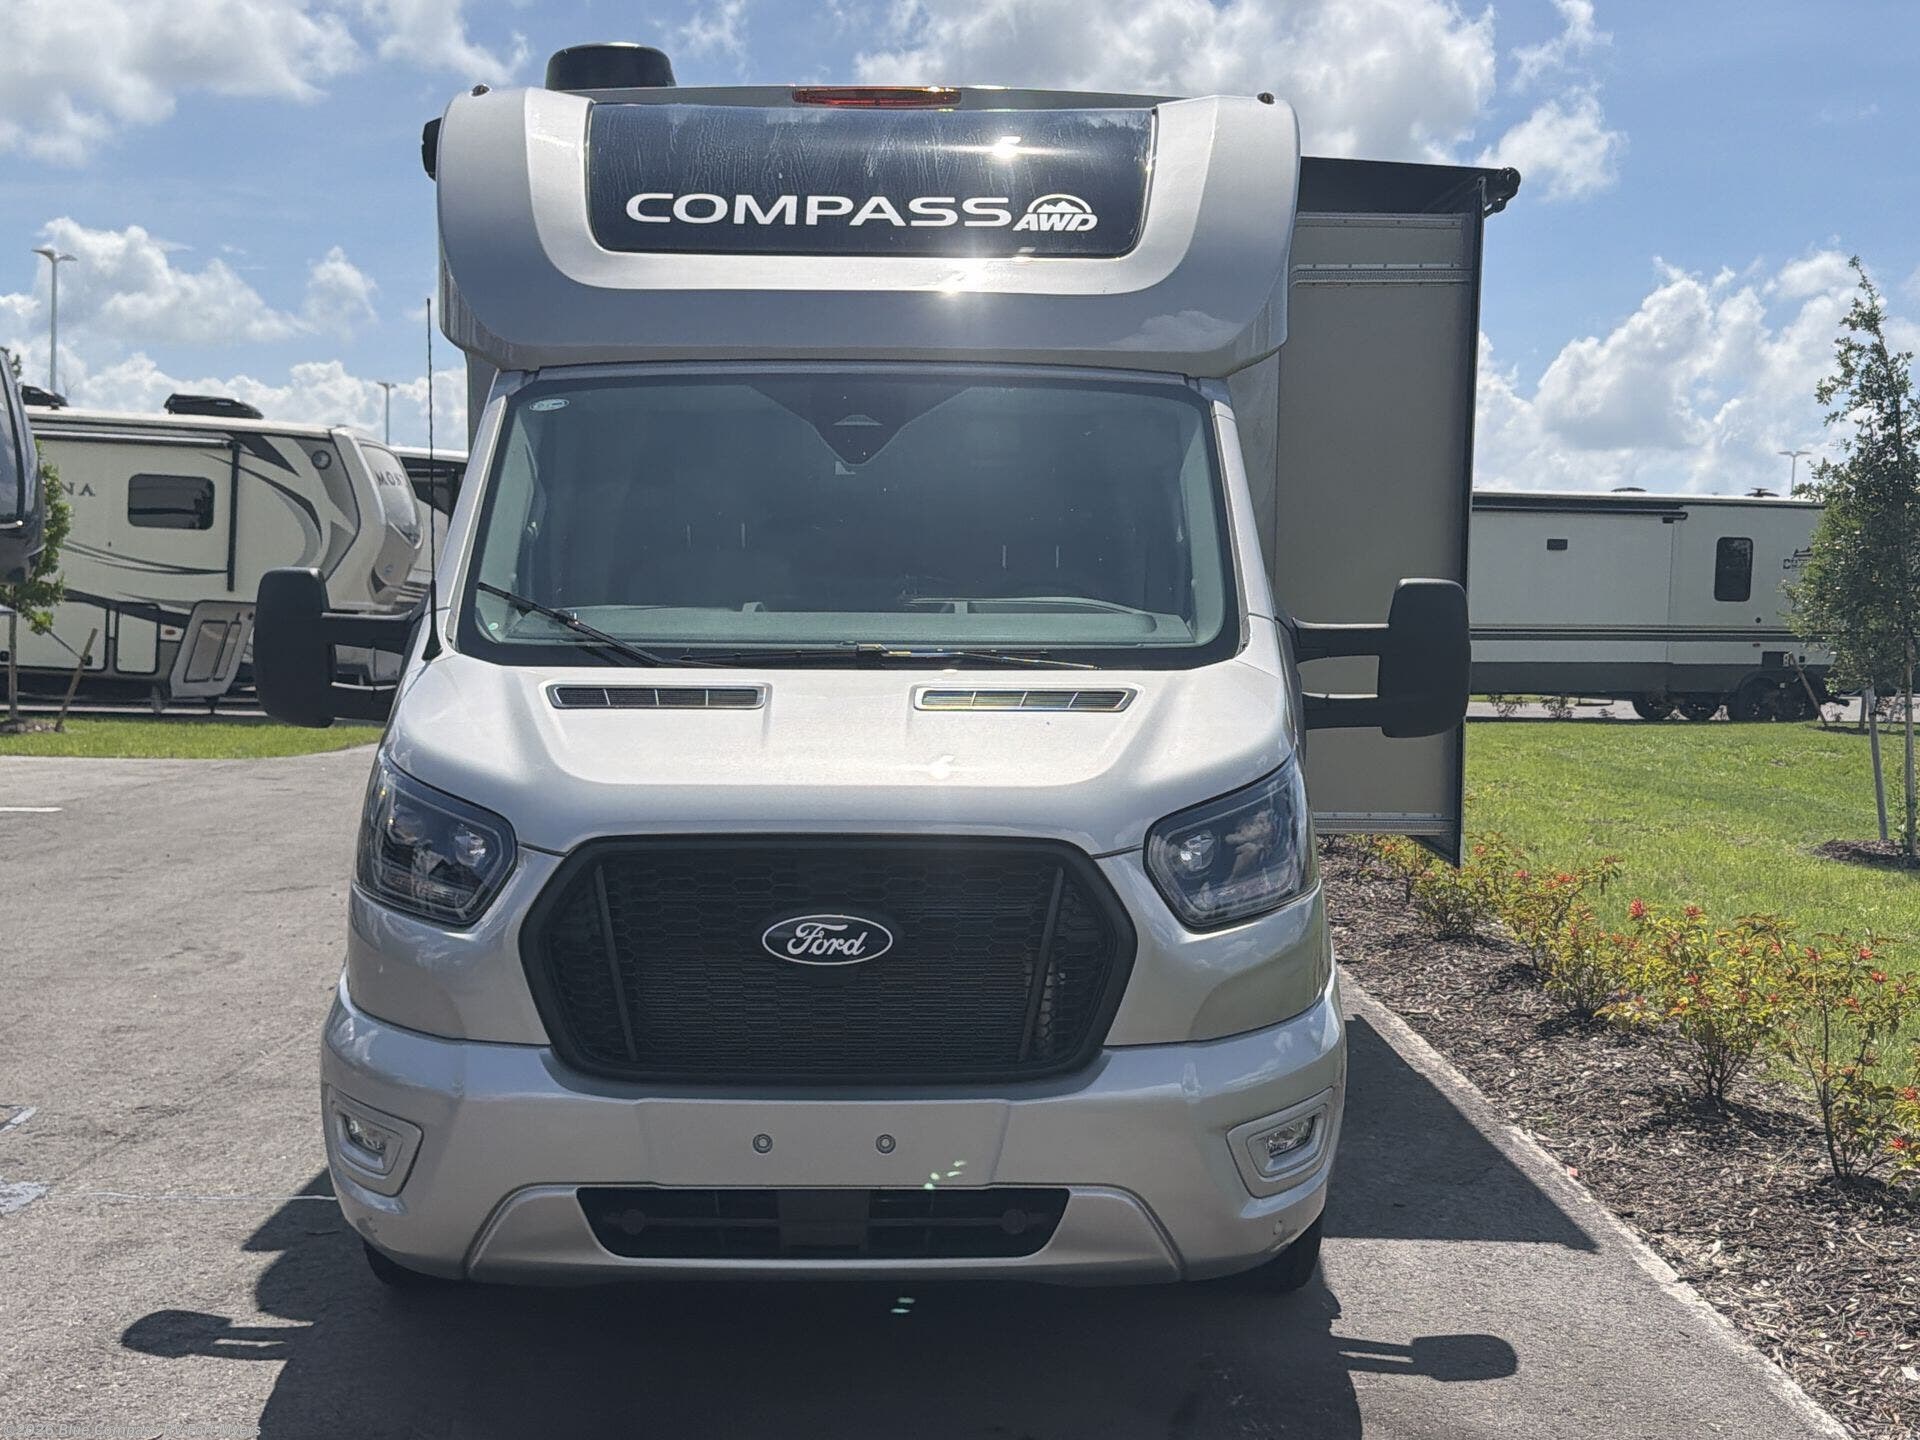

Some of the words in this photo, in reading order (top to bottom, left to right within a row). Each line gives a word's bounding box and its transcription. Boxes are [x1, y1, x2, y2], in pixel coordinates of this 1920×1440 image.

[625, 193, 1012, 227] COMPASS
[1012, 213, 1098, 231] AWD
[786, 922, 868, 956] Ford
